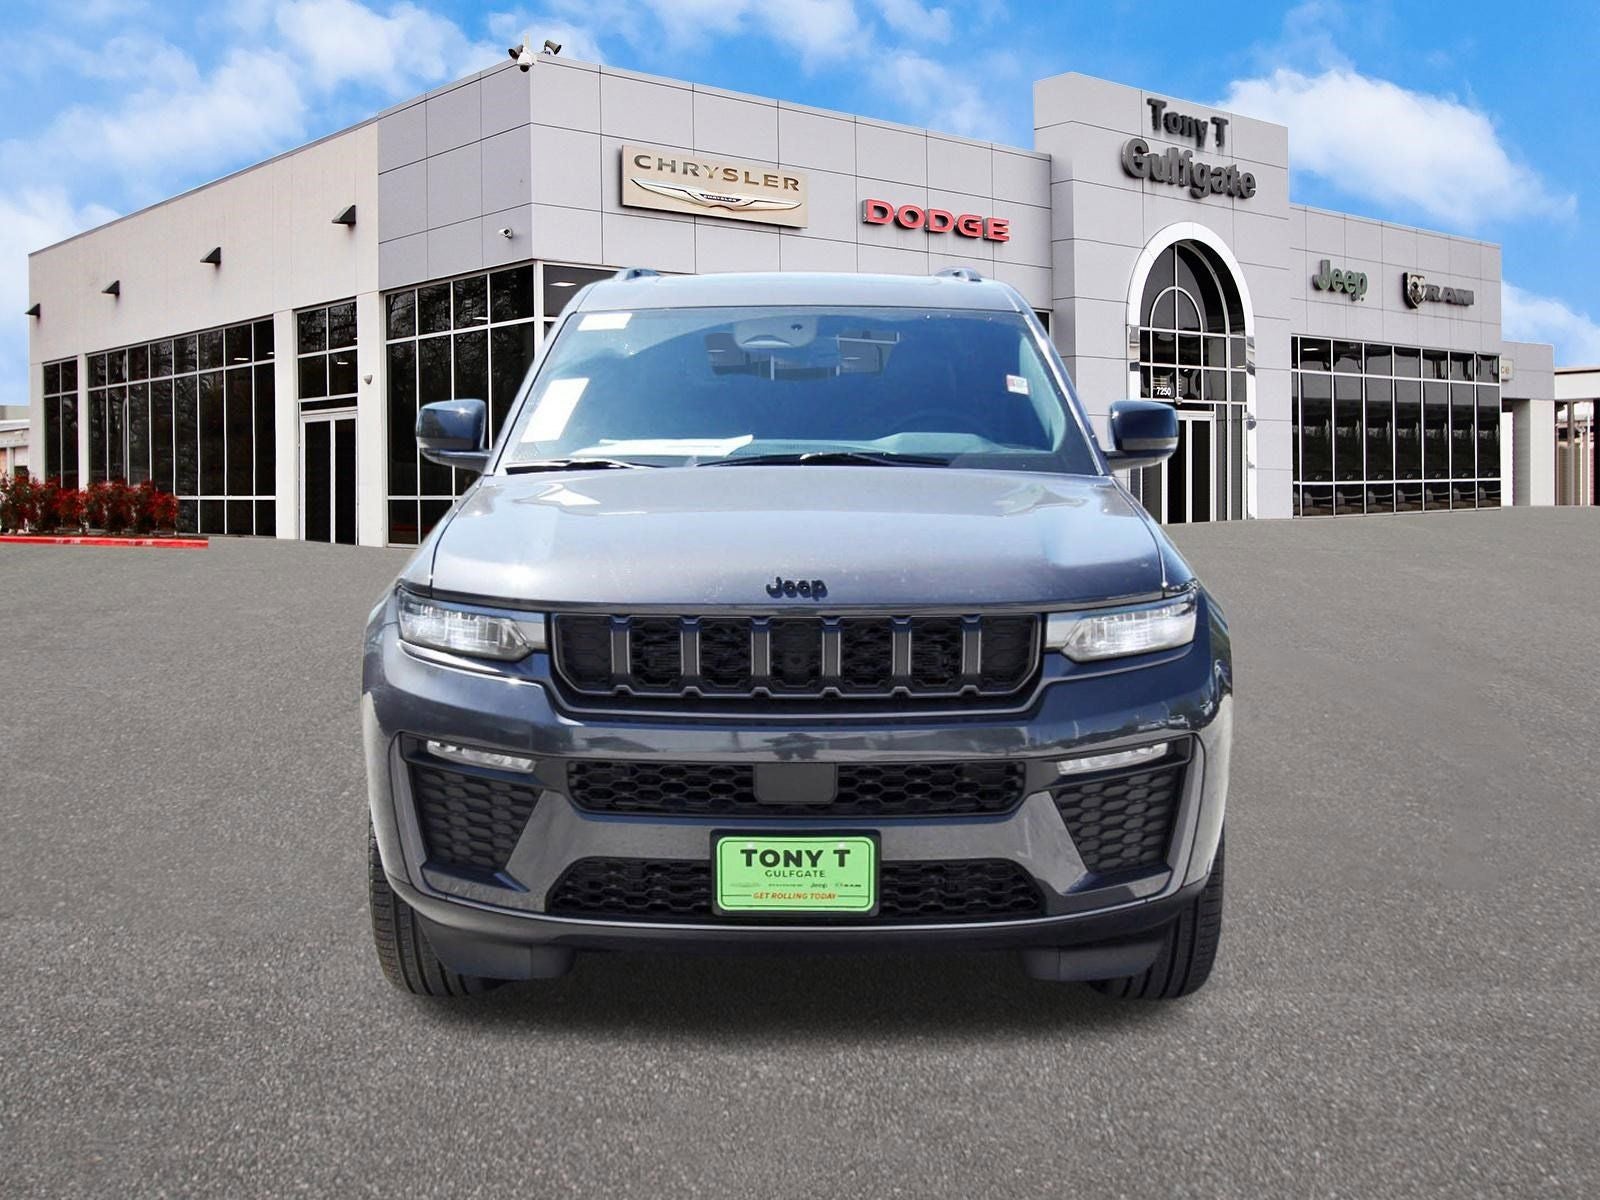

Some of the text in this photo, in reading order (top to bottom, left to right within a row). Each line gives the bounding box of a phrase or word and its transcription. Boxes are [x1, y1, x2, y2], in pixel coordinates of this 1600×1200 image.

[1147, 98, 1229, 147] Tony T
[633, 154, 800, 191] CHRYSLER
[1121, 138, 1256, 199] Gulfgate
[862, 199, 1010, 242] DODGE
[1313, 259, 1368, 302] Jeep
[1424, 283, 1475, 307] RAM
[1156, 387, 1171, 396] 7250
[766, 576, 828, 602] Jeep
[740, 849, 851, 868] TONY T
[764, 869, 826, 878] GULFGATE
[753, 892, 837, 900] GET ROLLING TODAY
